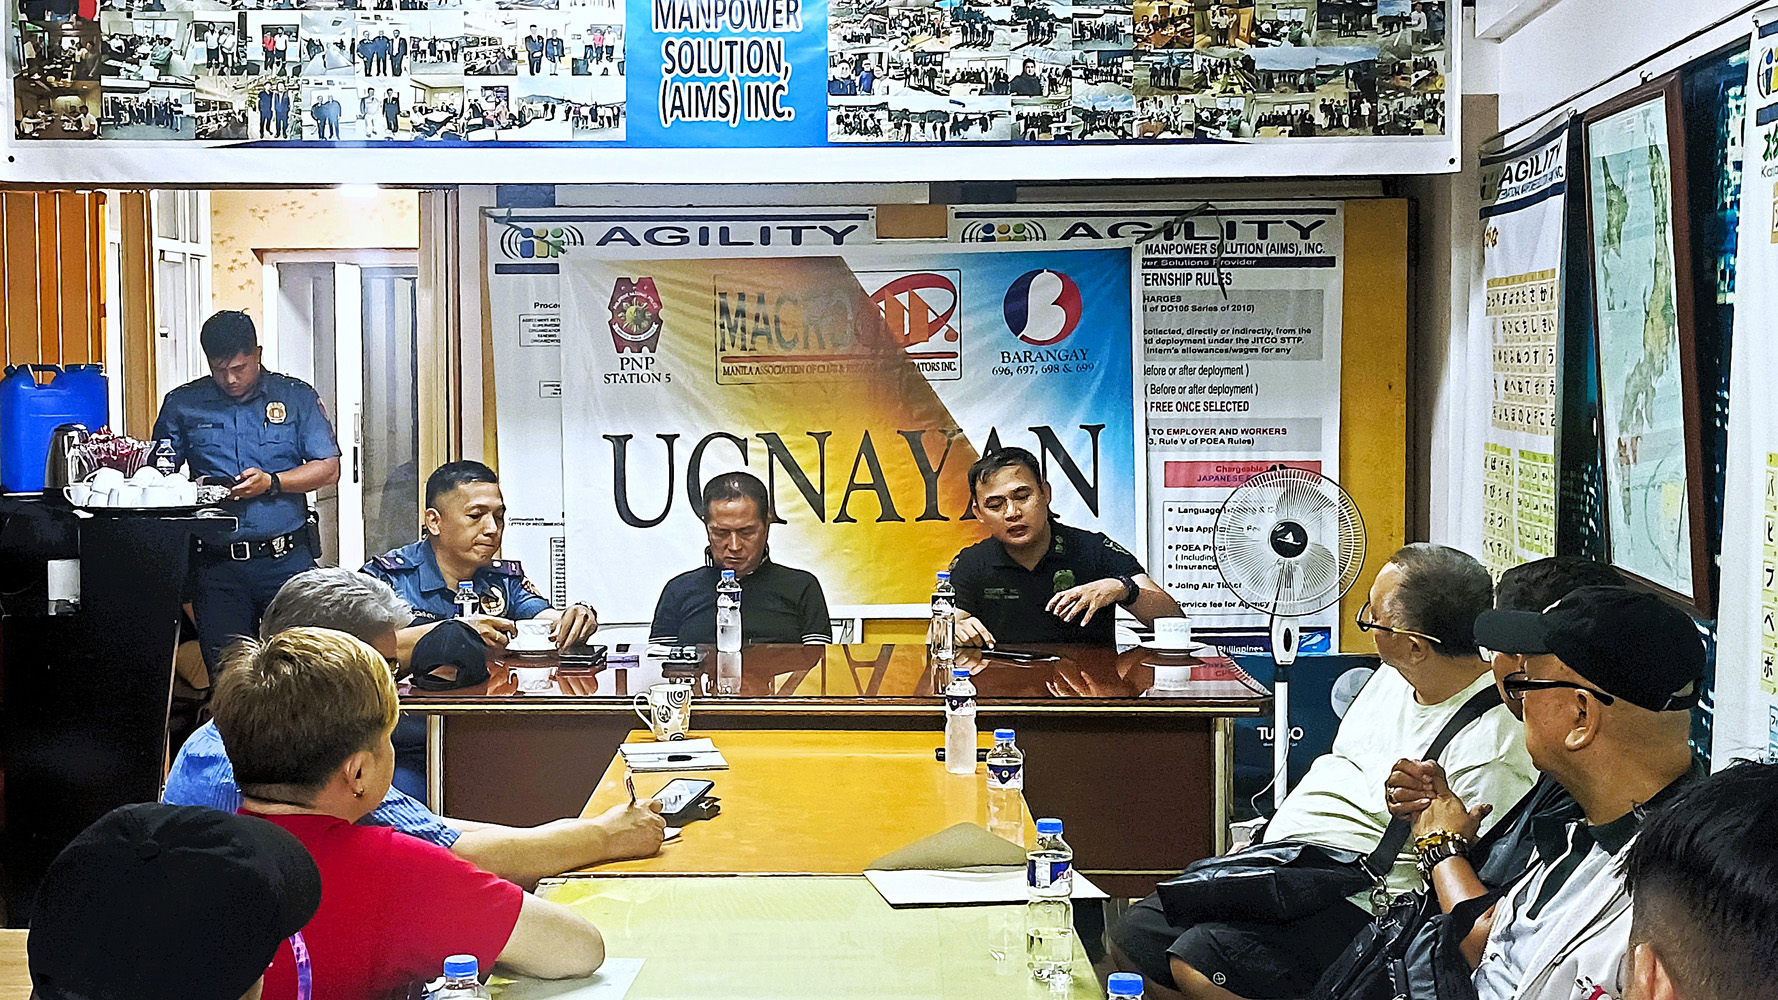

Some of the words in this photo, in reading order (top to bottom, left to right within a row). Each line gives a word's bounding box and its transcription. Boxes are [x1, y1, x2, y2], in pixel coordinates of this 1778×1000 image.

[654, 0, 801, 30] MANPOWER
[664, 39, 790, 81] SOLUTION,
[661, 79, 740, 125] (AIMS)
[747, 83, 793, 119] INC.
[595, 225, 859, 246] AGILITY
[1058, 219, 1326, 241] AGILITY
[1145, 243, 1208, 255] MANPOWER
[1210, 243, 1264, 255] SLUTION
[1265, 243, 1302, 256] (AIMS),
[1304, 243, 1326, 255] INC.
[1186, 328, 1218, 336] directly
[1232, 328, 1274, 336] indirectly,
[1298, 327, 1312, 335] the
[1155, 337, 1206, 347] deployment
[1251, 336, 1278, 344] JITCO
[1001, 348, 1089, 364] BARANGAY
[1275, 347, 1292, 355] any
[619, 356, 655, 371] PNP
[941, 361, 957, 372] INC.
[992, 366, 1013, 377] 696,
[1016, 365, 1038, 375] 697,
[1041, 364, 1060, 374] 698
[1062, 363, 1072, 373] &
[1076, 362, 1095, 372] 699
[1168, 366, 1177, 375] or
[1178, 364, 1197, 375] after
[1198, 364, 1244, 378] deployment
[603, 373, 662, 384] STATION
[664, 373, 672, 383] 5
[1150, 383, 1177, 395] Before
[1178, 385, 1187, 395] or
[1188, 383, 1206, 395] after
[1208, 383, 1254, 397] deployment
[1150, 401, 1174, 412] FREE
[1175, 401, 1201, 412] ONCE
[1202, 401, 1250, 412] SELECTED
[1227, 438, 1255, 447] Rules)
[602, 423, 1106, 528] UGNAYN
[1215, 465, 1265, 475] Chargeable
[1196, 475, 1245, 483] JAPANESE
[1178, 506, 1222, 516] Language
[1175, 544, 1200, 552] POEA
[1257, 727, 1304, 741] TUO
